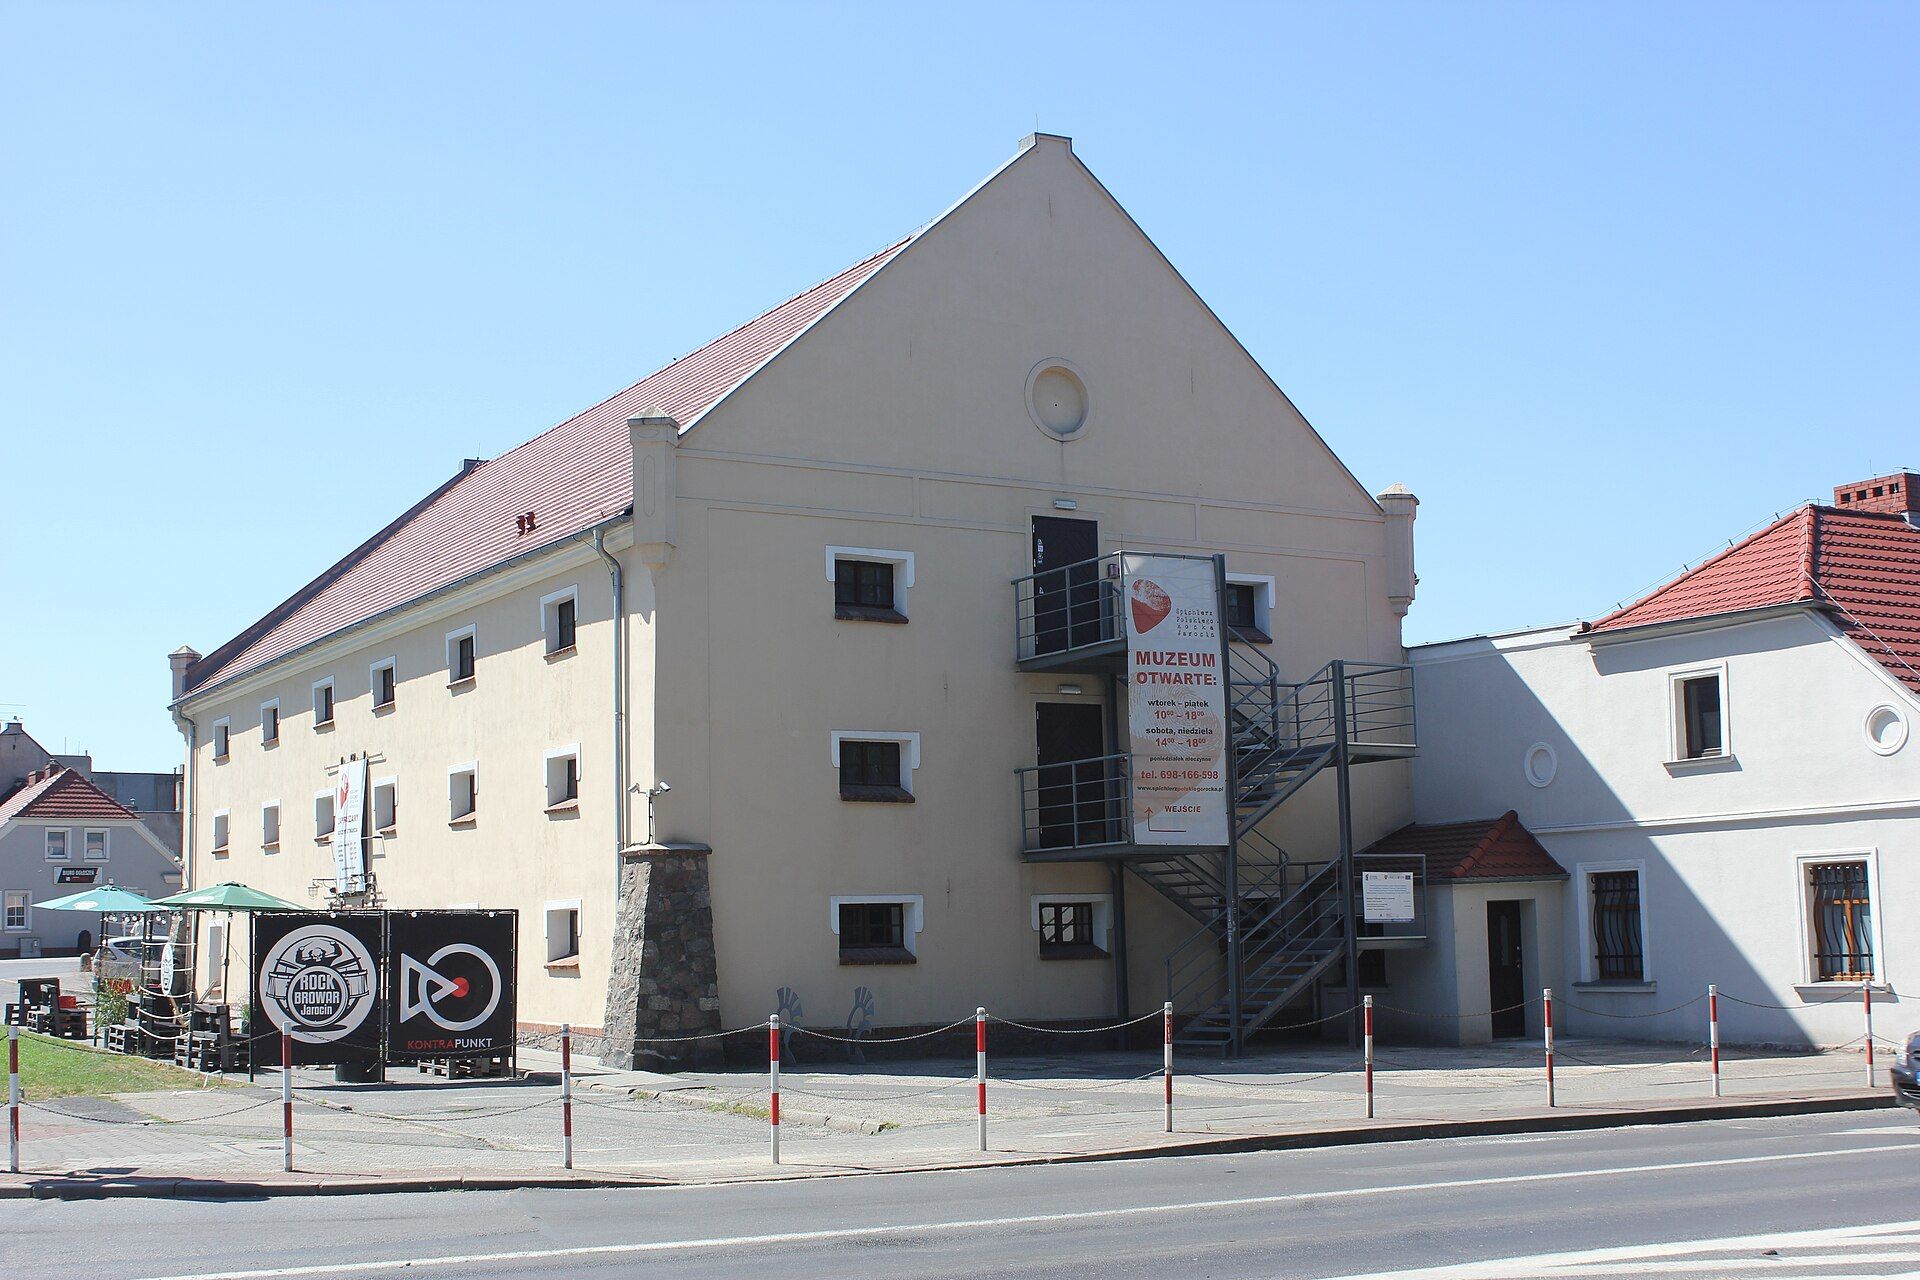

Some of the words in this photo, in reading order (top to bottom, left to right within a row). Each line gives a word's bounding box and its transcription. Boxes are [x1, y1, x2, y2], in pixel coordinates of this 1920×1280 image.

[1176, 608, 1213, 616] Spichlerz
[1176, 617, 1214, 625] Polskiego
[1136, 651, 1215, 667] MUZEUM
[1136, 672, 1217, 686] OTWARTE:
[1184, 700, 1209, 708] piątek
[1146, 727, 1176, 736] sobota,
[1141, 770, 1157, 779] tel.
[1160, 770, 1218, 780] 698-166-598
[1164, 804, 1201, 812] WEJŚCIE
[300, 974, 336, 990] ROCK
[294, 992, 340, 1004] BROWAR
[300, 1004, 332, 1015] Jarocin
[408, 1038, 493, 1050] KONTRAPUNKT
